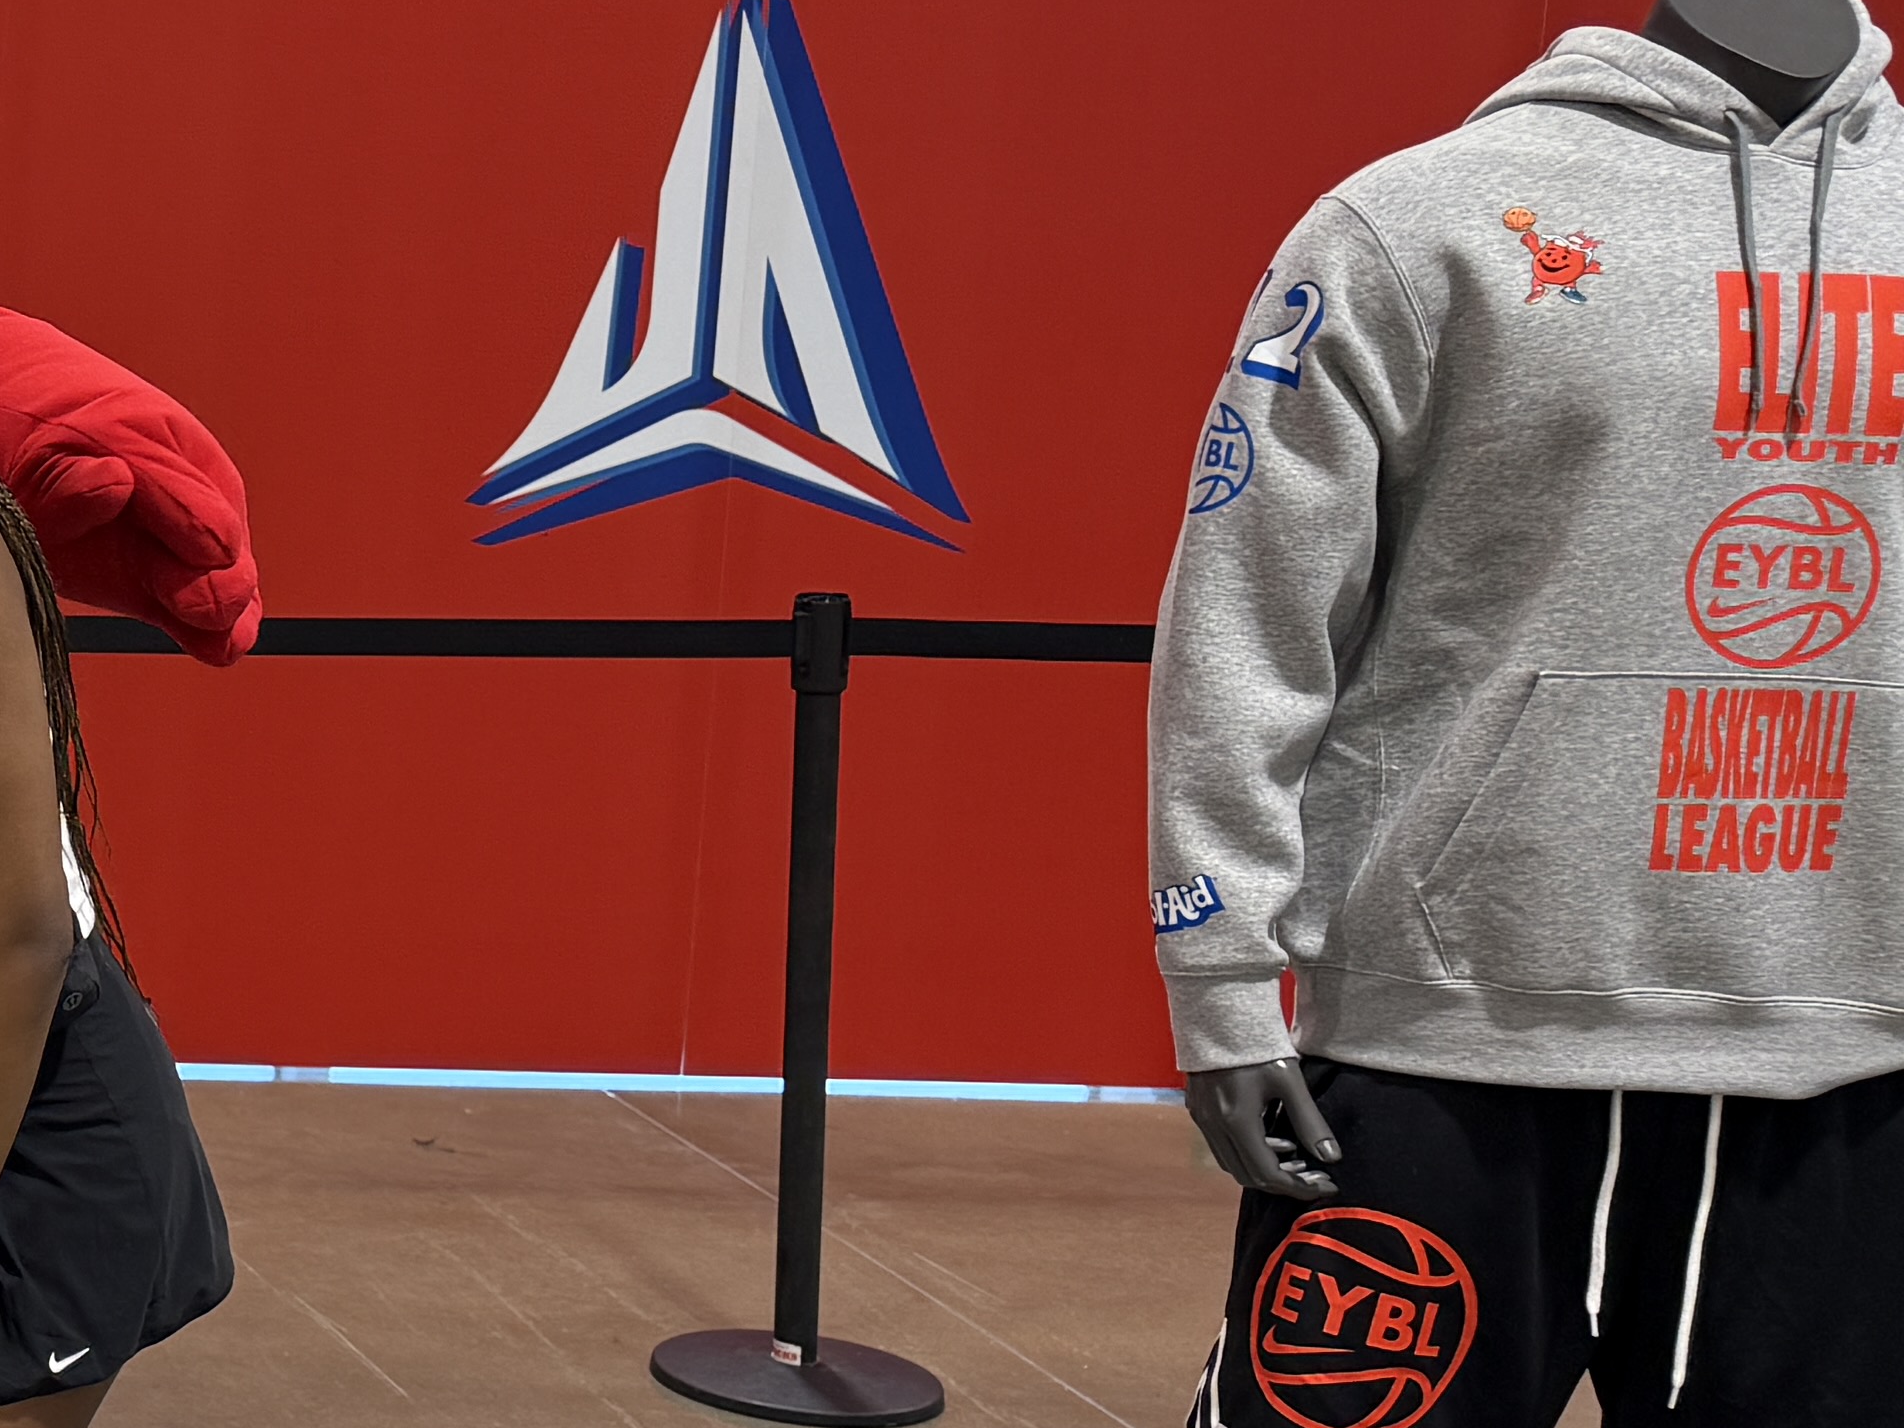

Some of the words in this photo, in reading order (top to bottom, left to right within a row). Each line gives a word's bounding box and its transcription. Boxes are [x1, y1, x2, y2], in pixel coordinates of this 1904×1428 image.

[1712, 270, 1904, 438] ELITE
[1712, 436, 1900, 466] YOUTH
[1711, 542, 1856, 593] EYBL
[1656, 686, 1858, 800] BASKETBALL
[1647, 803, 1843, 873] LEAGUE
[1269, 1260, 1441, 1358] EYBL
